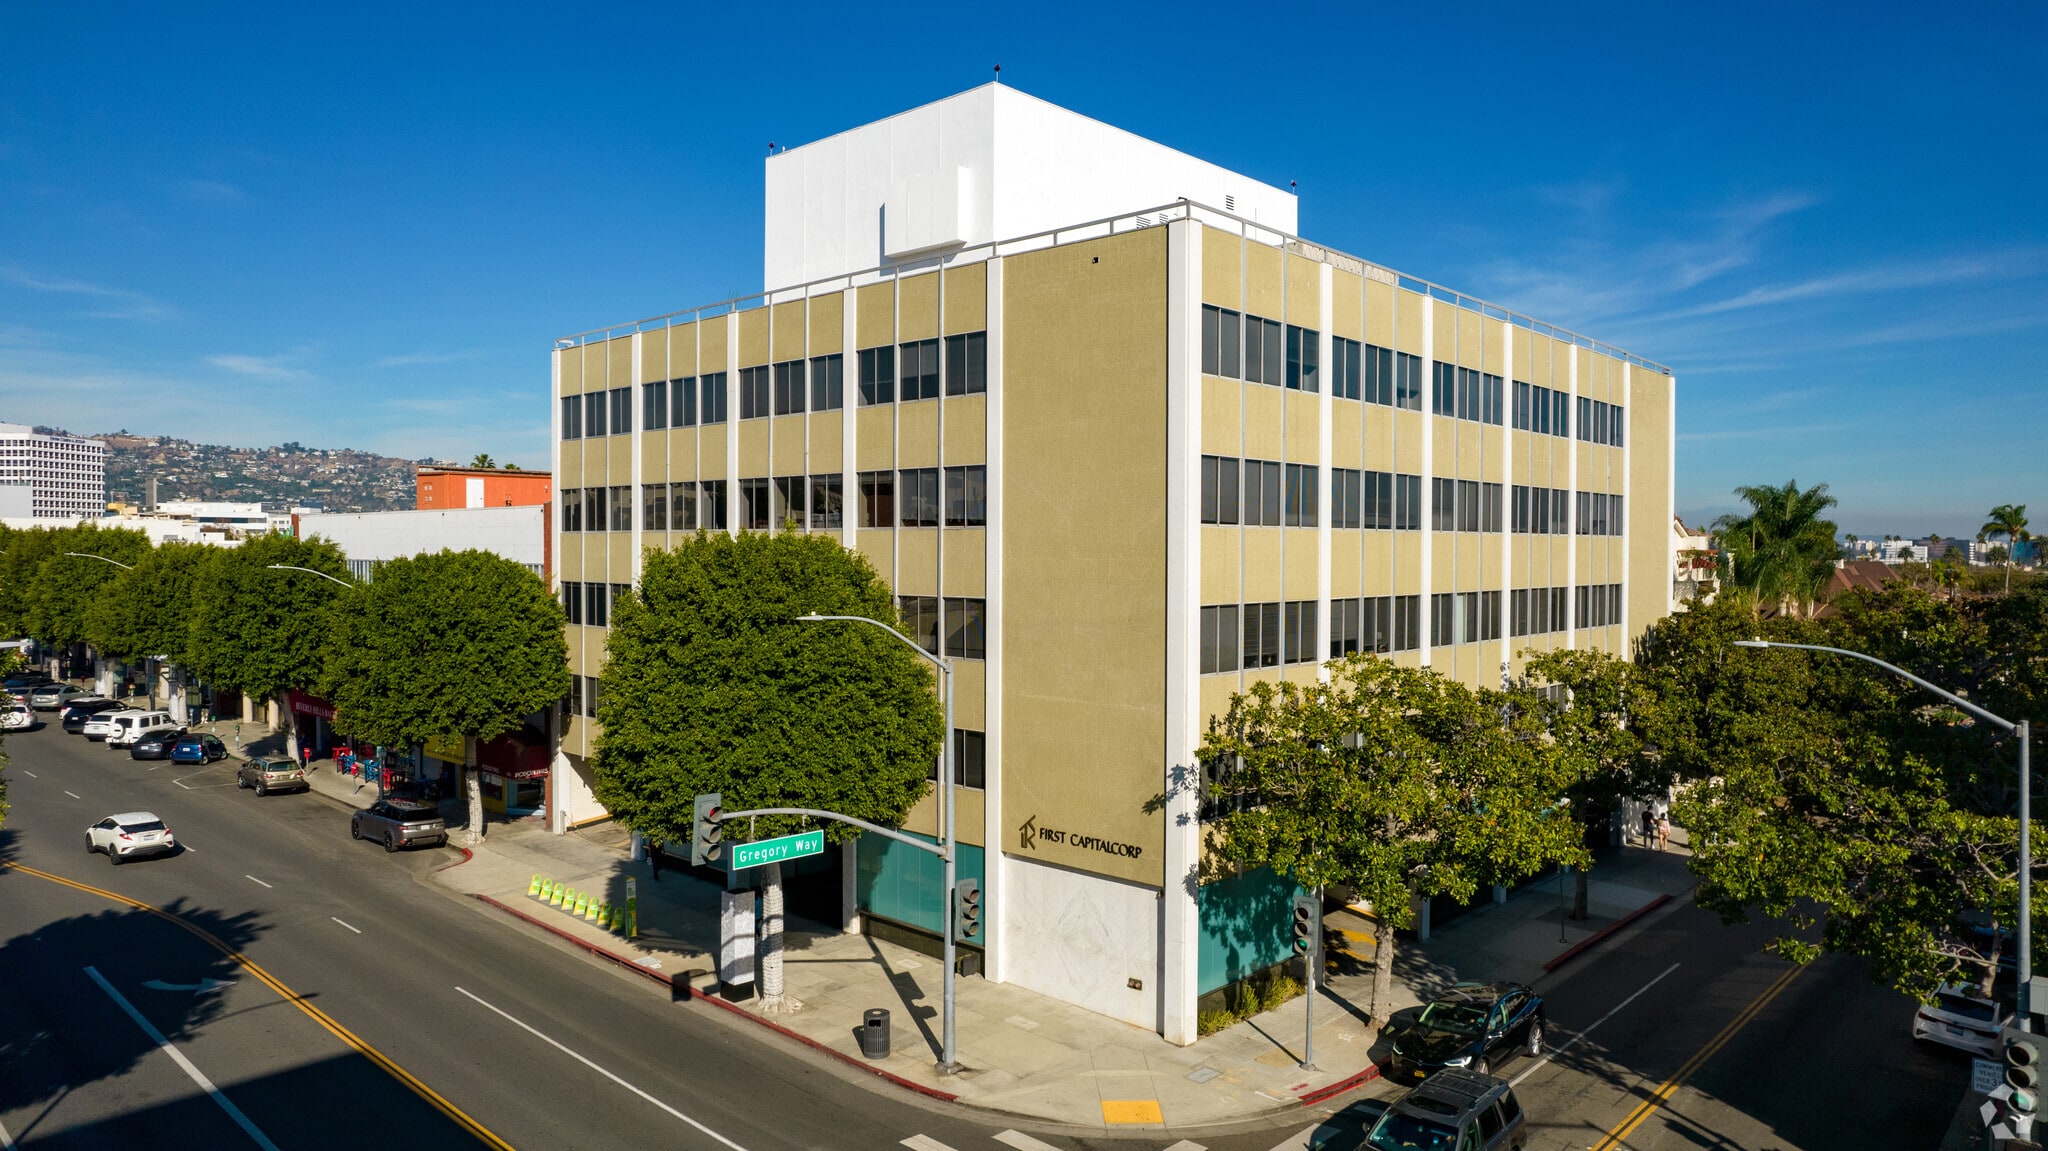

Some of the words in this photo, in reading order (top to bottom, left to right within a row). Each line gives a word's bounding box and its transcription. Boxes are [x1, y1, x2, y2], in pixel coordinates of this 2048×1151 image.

[739, 845, 788, 863] Gregory
[795, 839, 818, 852] Way
[1039, 827, 1066, 843] FIRST
[1069, 833, 1143, 859] CAPITALCORP
